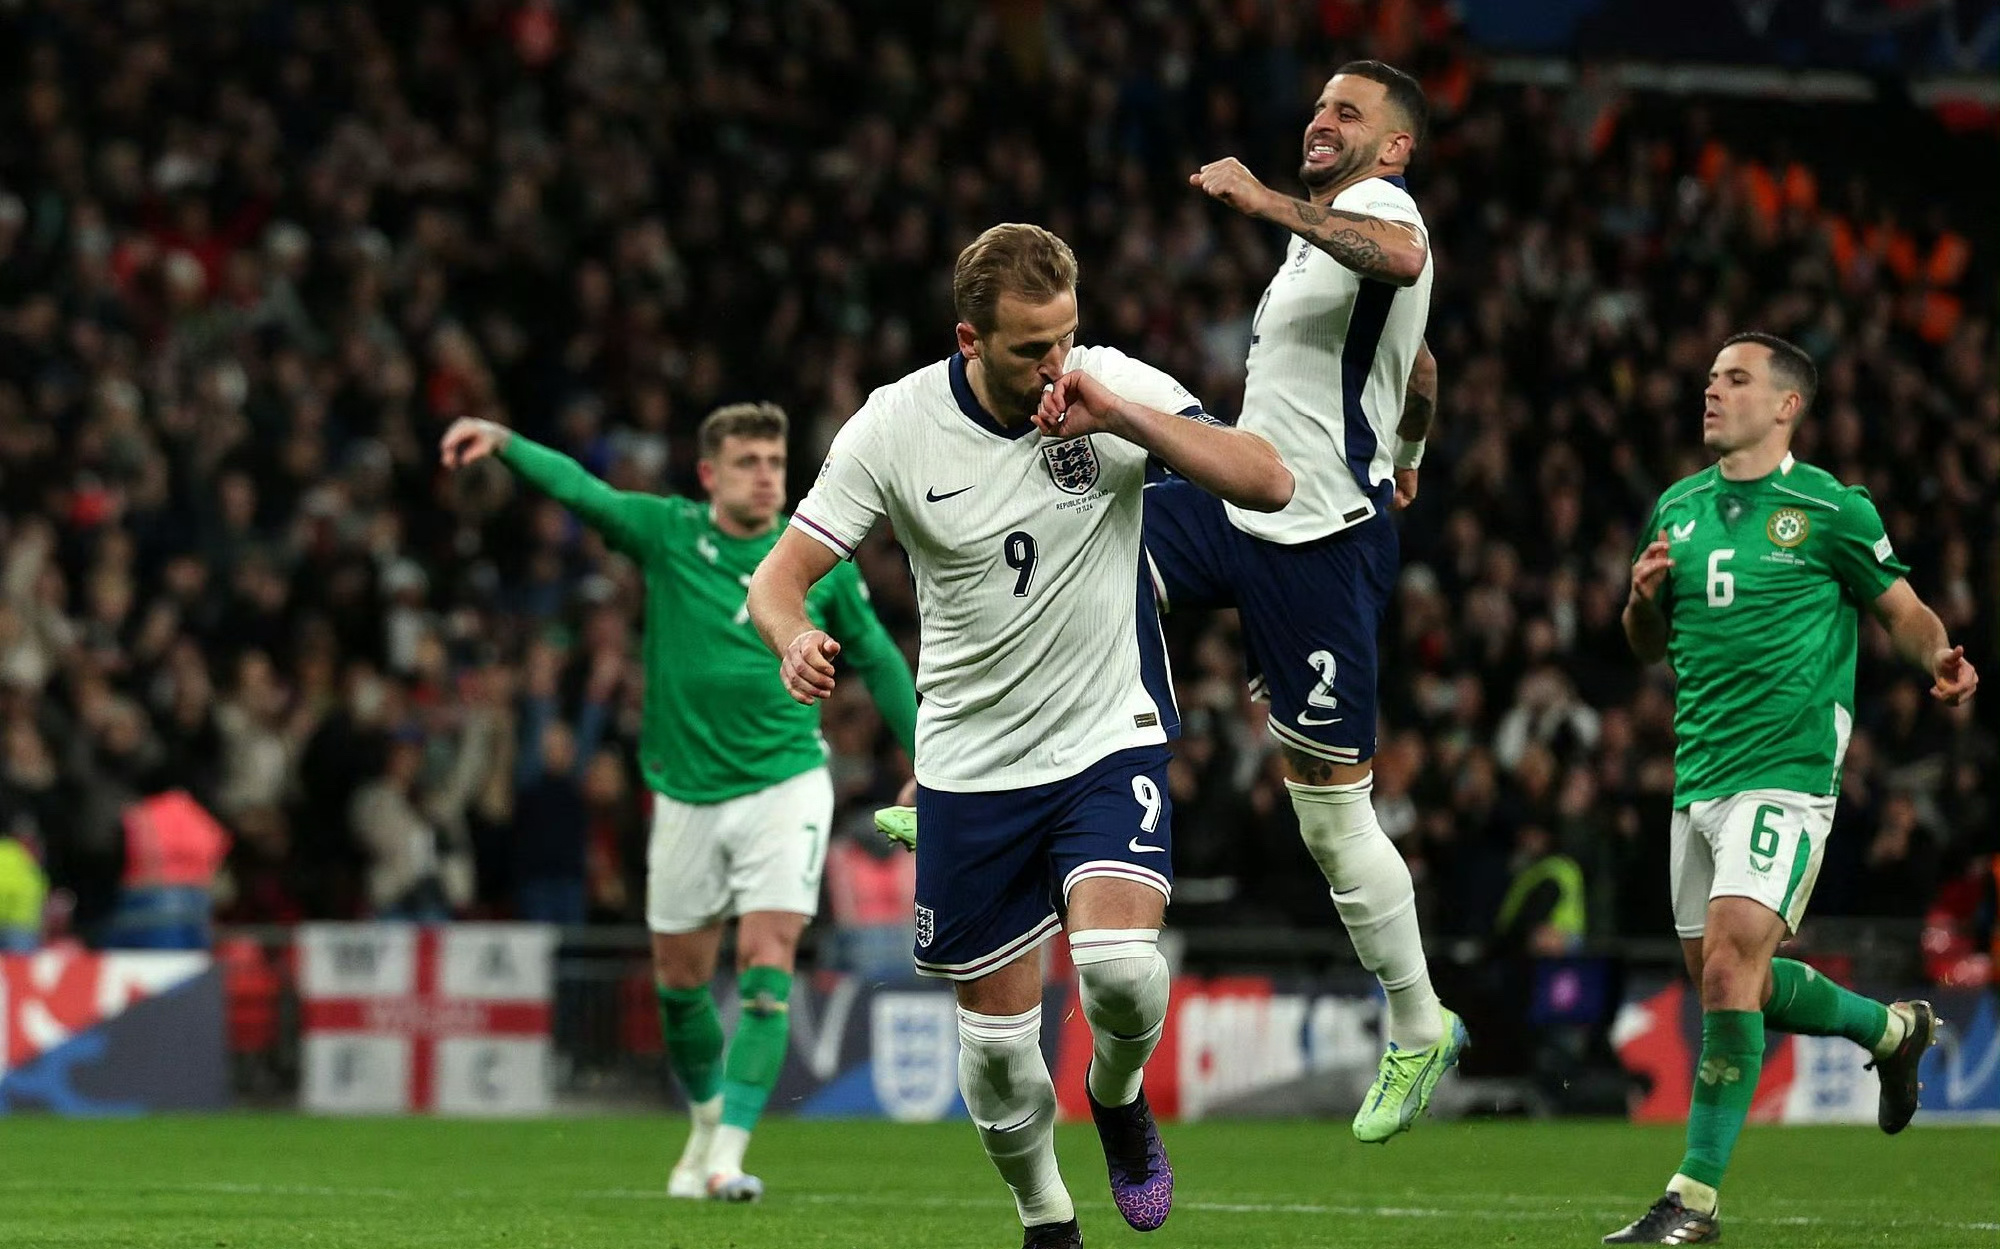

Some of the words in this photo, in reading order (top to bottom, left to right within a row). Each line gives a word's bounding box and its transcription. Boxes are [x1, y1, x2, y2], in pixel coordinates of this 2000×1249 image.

[1056, 497, 1081, 511] REPUBLIC
[1003, 530, 1039, 598] 9
[1706, 549, 1736, 608] 6
[1306, 649, 1338, 710] 2
[1131, 774, 1162, 834] 9
[1749, 804, 1785, 858] 6
[801, 822, 819, 872] 7
